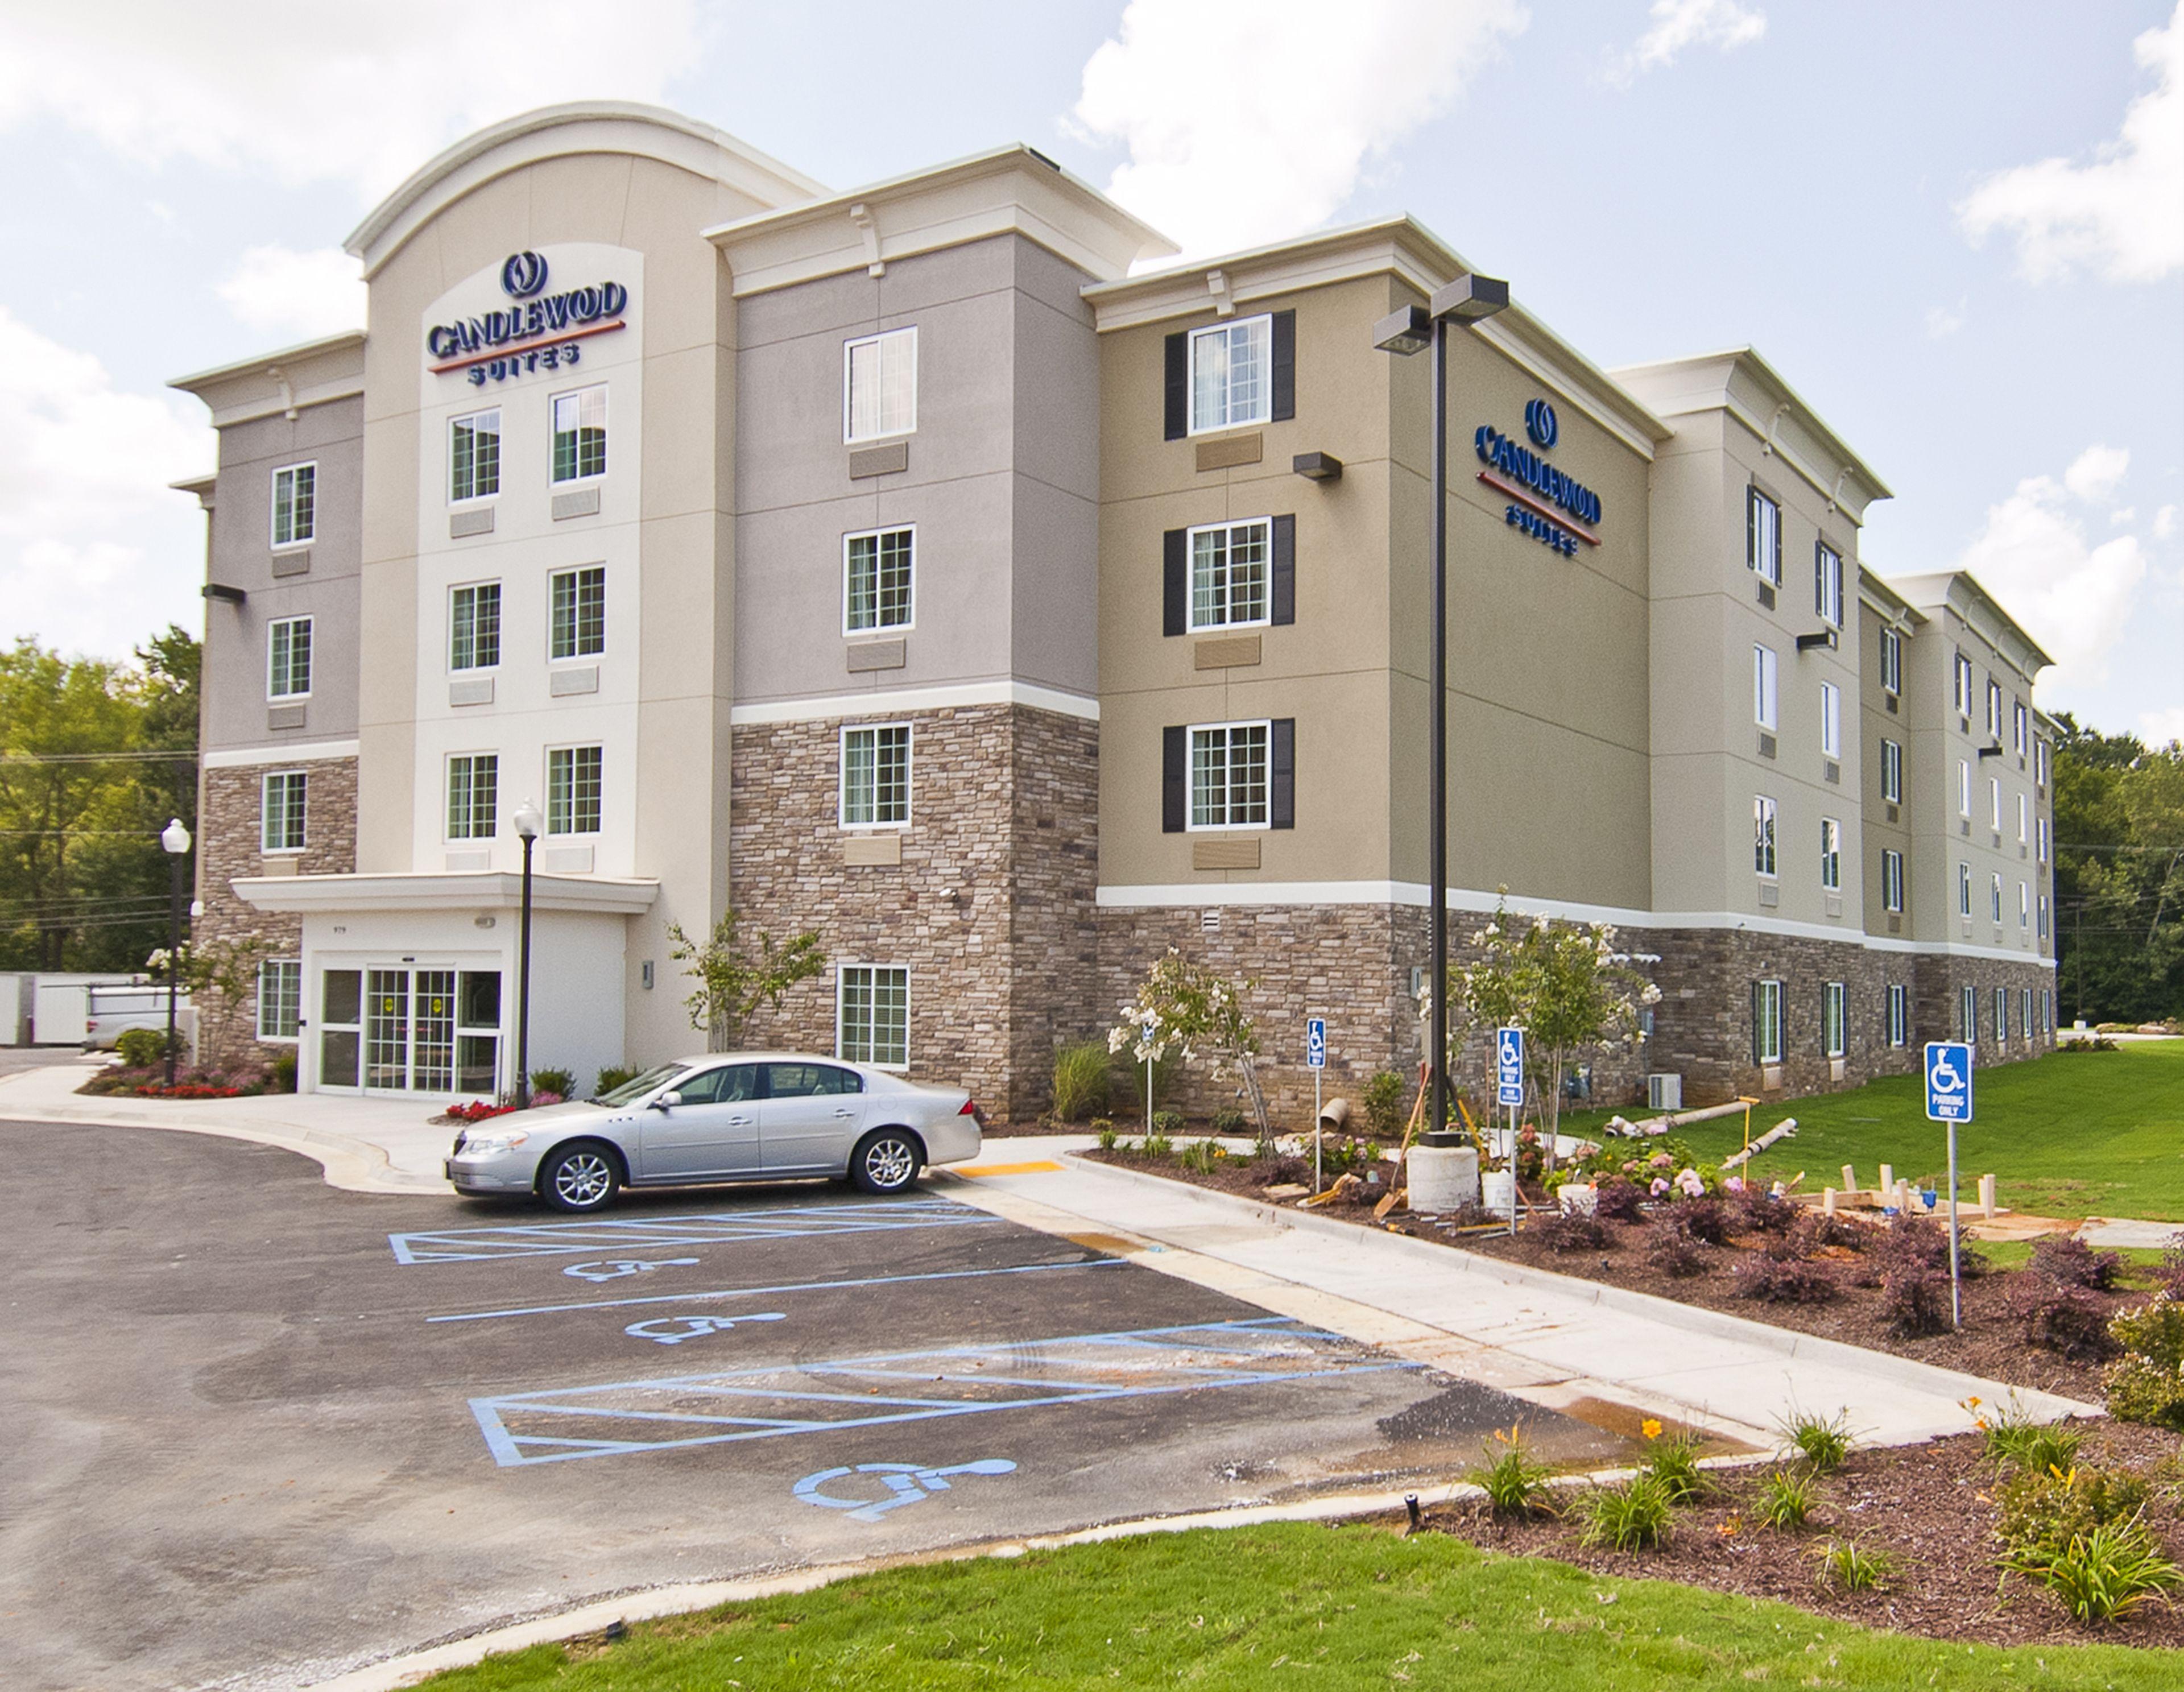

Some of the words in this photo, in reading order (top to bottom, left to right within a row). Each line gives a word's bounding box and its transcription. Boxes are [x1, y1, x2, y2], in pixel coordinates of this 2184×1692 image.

[427, 281, 627, 358] CANDLEWOOD
[468, 343, 580, 386] SUITES
[1475, 425, 1601, 525] CANDLEWOOD
[1505, 503, 1578, 557] SUITES
